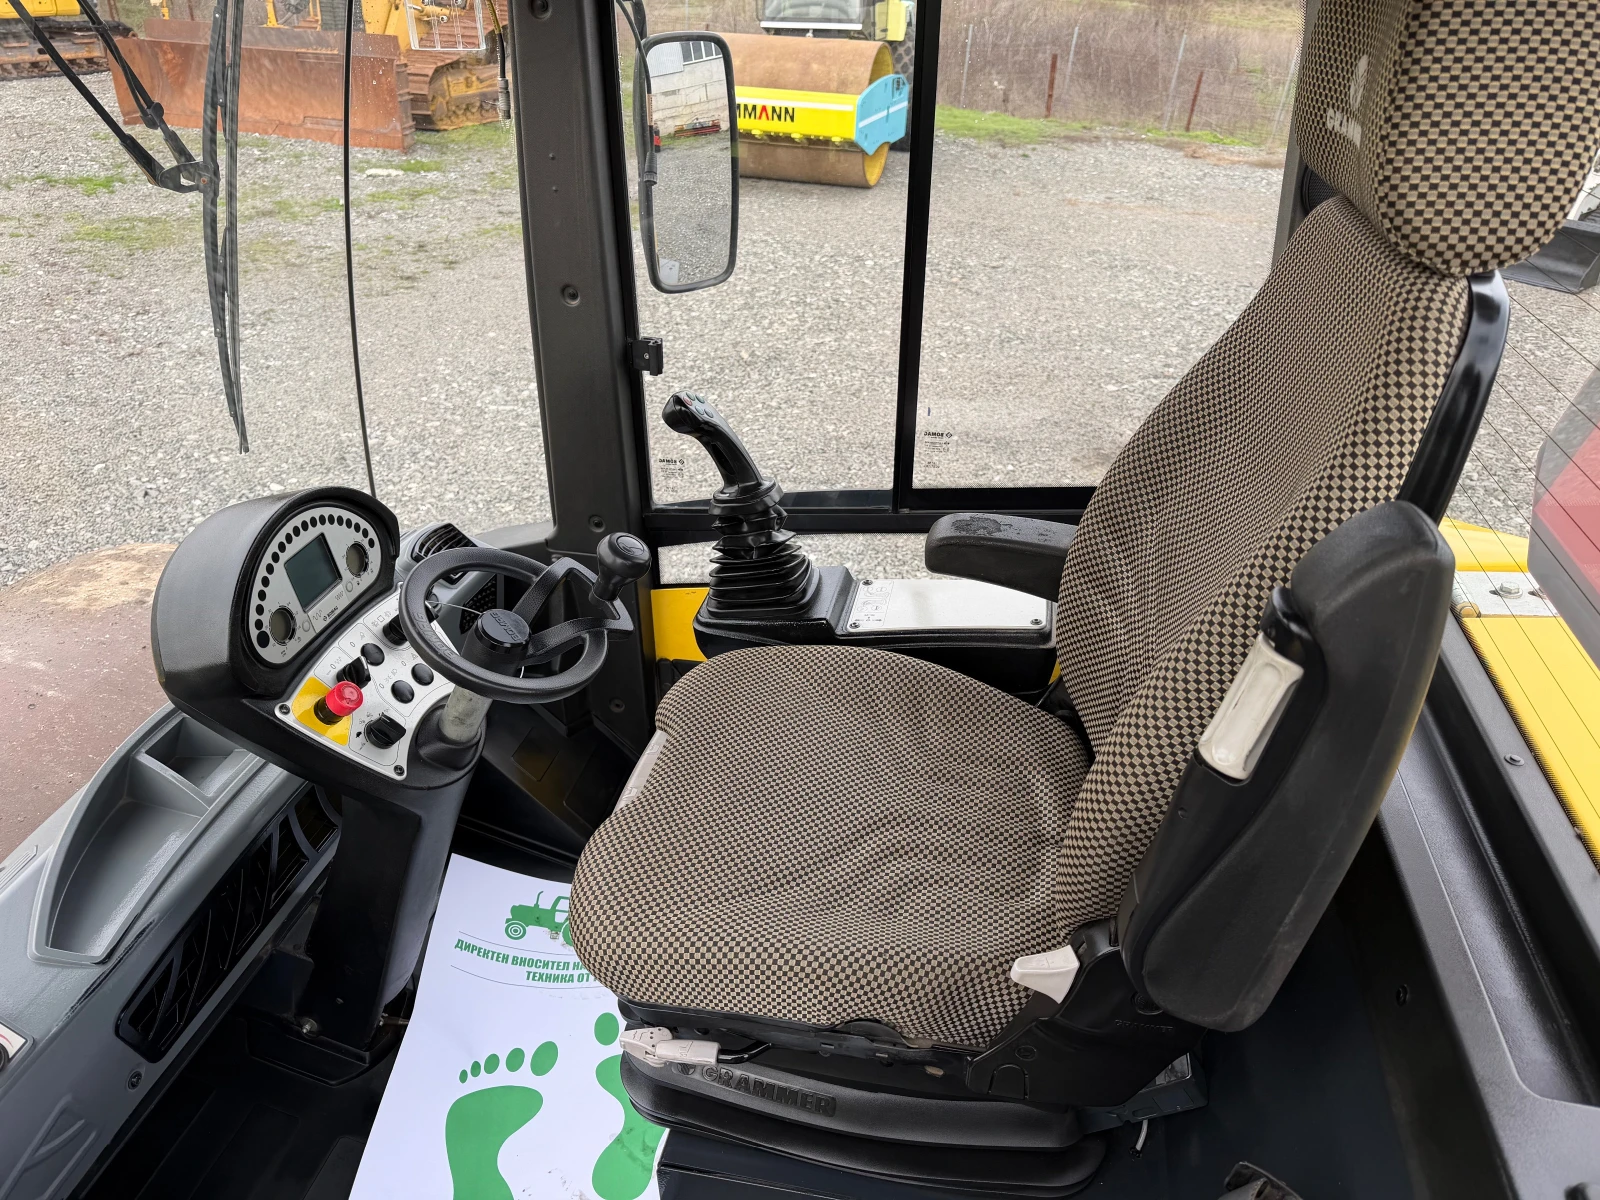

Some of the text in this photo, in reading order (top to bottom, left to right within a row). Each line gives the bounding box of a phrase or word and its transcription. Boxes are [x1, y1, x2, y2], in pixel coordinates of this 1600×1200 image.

[454, 938, 509, 964] ДИРЕКТЕН
[511, 956, 570, 971] ВНОСИТЕЛ
[525, 970, 575, 983] ТЕХНИКА
[577, 972, 591, 983] ОТ
[701, 1065, 833, 1116] GRAMMER
